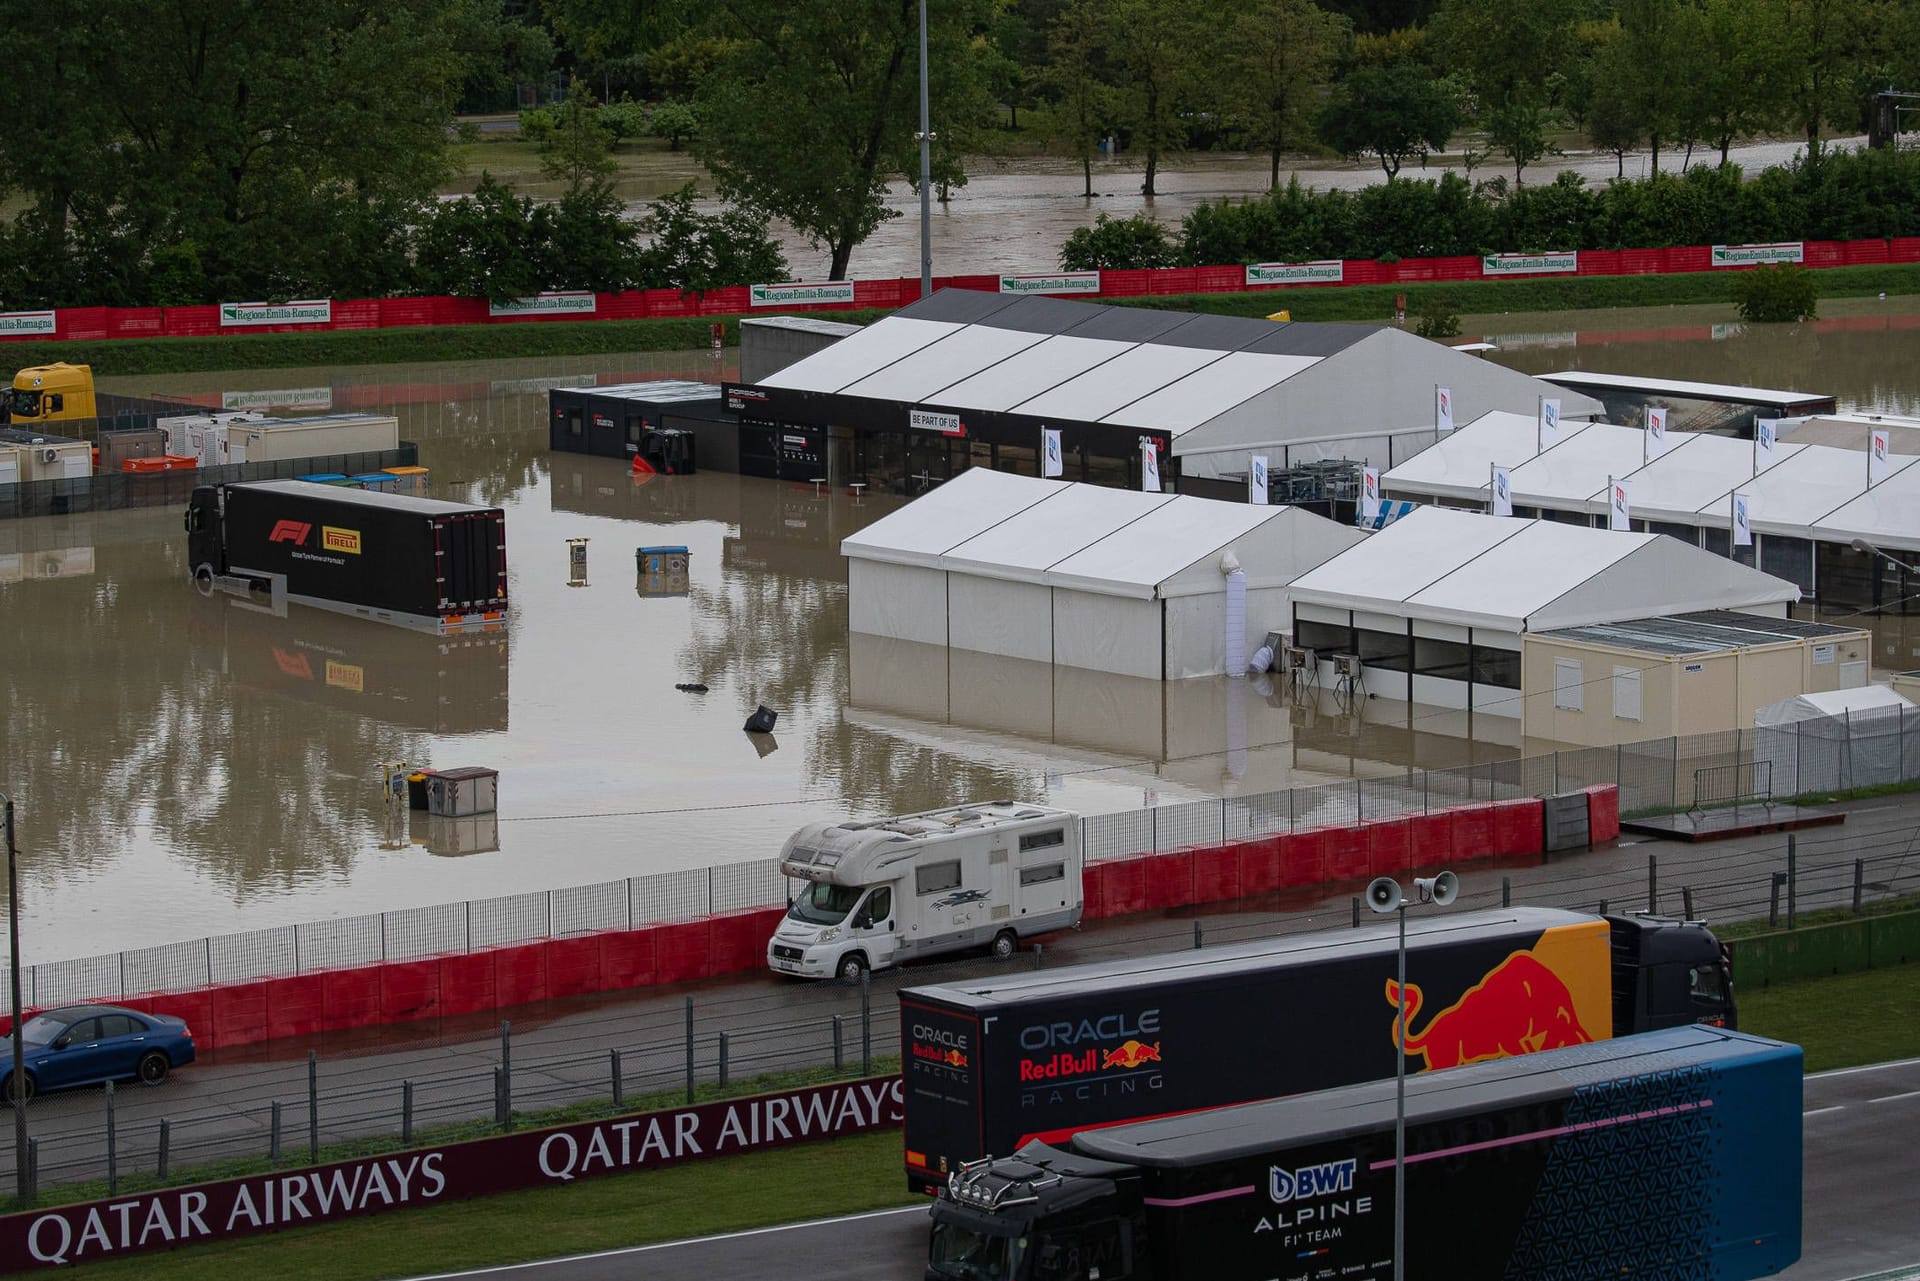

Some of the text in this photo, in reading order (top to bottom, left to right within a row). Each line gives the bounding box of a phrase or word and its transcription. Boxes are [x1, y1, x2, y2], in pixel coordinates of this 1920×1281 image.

[912, 414, 958, 428] BE PART OF US
[326, 530, 358, 549] PIRELLI
[913, 1024, 967, 1049] ORACLE
[1020, 1009, 1160, 1049] ORACLE
[914, 1062, 969, 1084] RACING
[1020, 1049, 1097, 1081] Red Bull
[1022, 1074, 1163, 1108] RACING
[538, 1079, 904, 1179] QATAR AIRWAYS
[1295, 1158, 1357, 1199] BWT
[28, 1152, 445, 1264] QATAR AIRWAYS
[1254, 1197, 1372, 1233] ALPINE
[1306, 1227, 1342, 1243] TEAM
